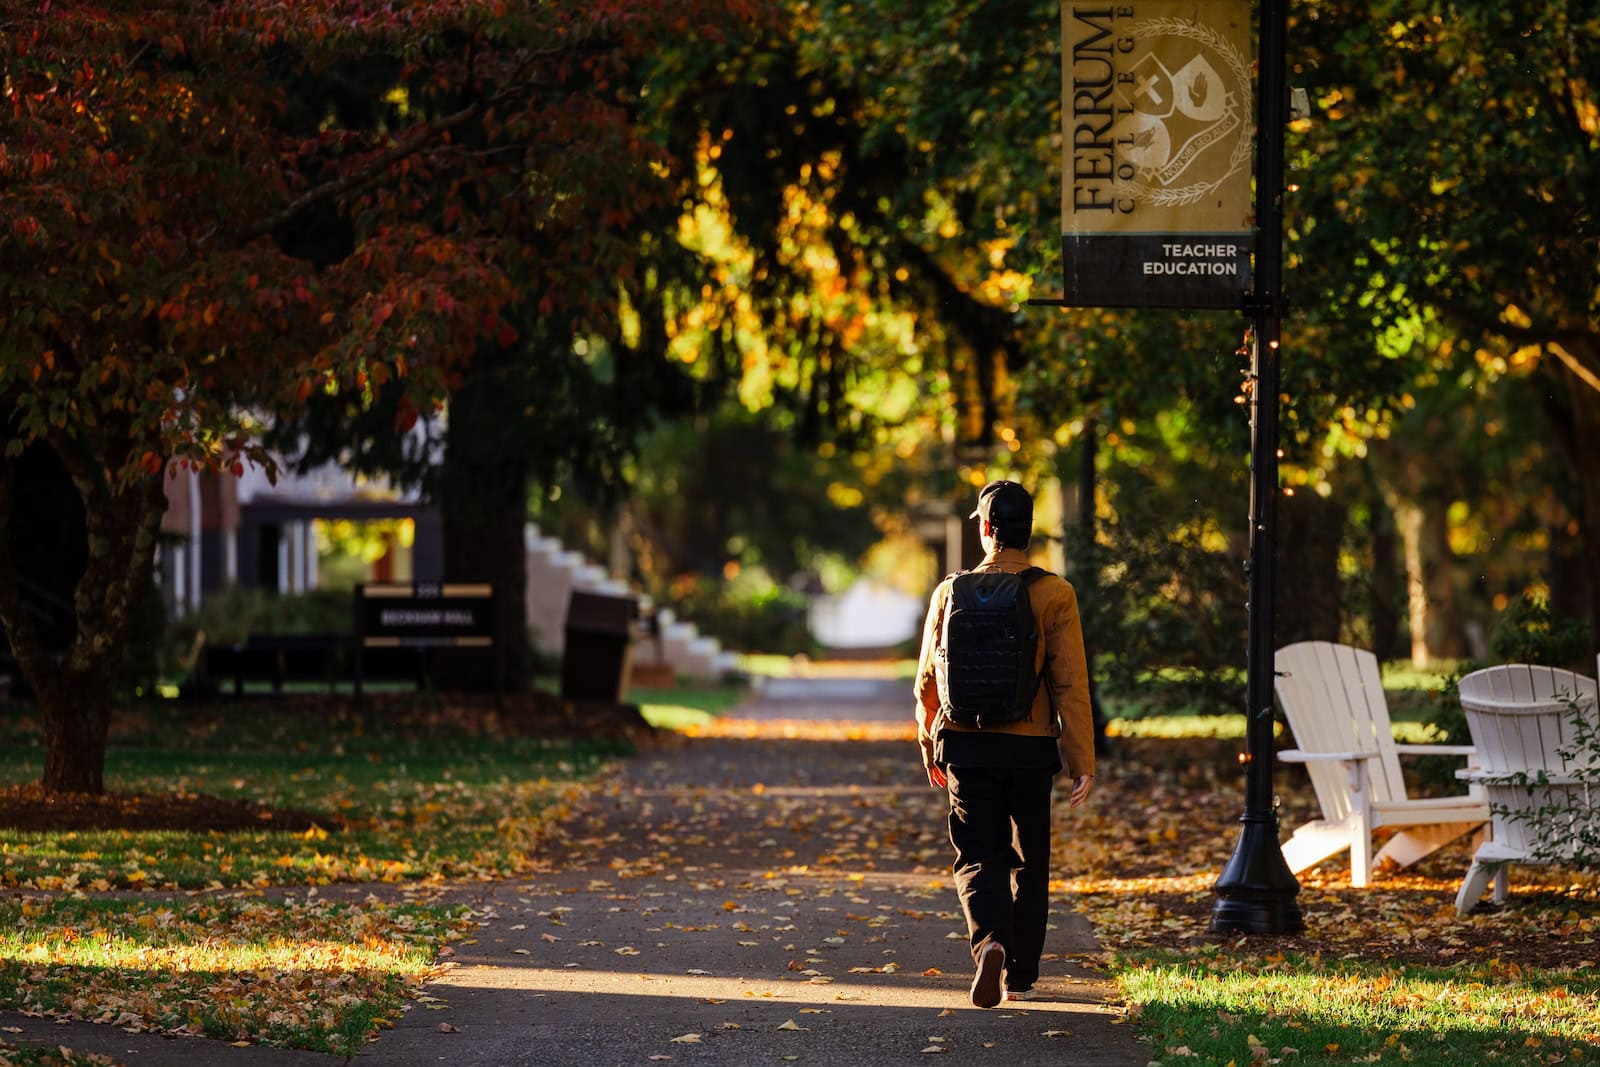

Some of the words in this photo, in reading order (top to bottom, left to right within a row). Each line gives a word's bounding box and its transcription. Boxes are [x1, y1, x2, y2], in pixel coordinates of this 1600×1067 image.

[1073, 6, 1115, 214] FERRUM
[1117, 6, 1135, 214] COLLEGE
[1164, 158, 1184, 179] NON
[1194, 133, 1213, 149] SED
[1162, 244, 1237, 257] TEACHER
[1143, 262, 1237, 276] EDUCATION
[445, 609, 473, 625] HALL
